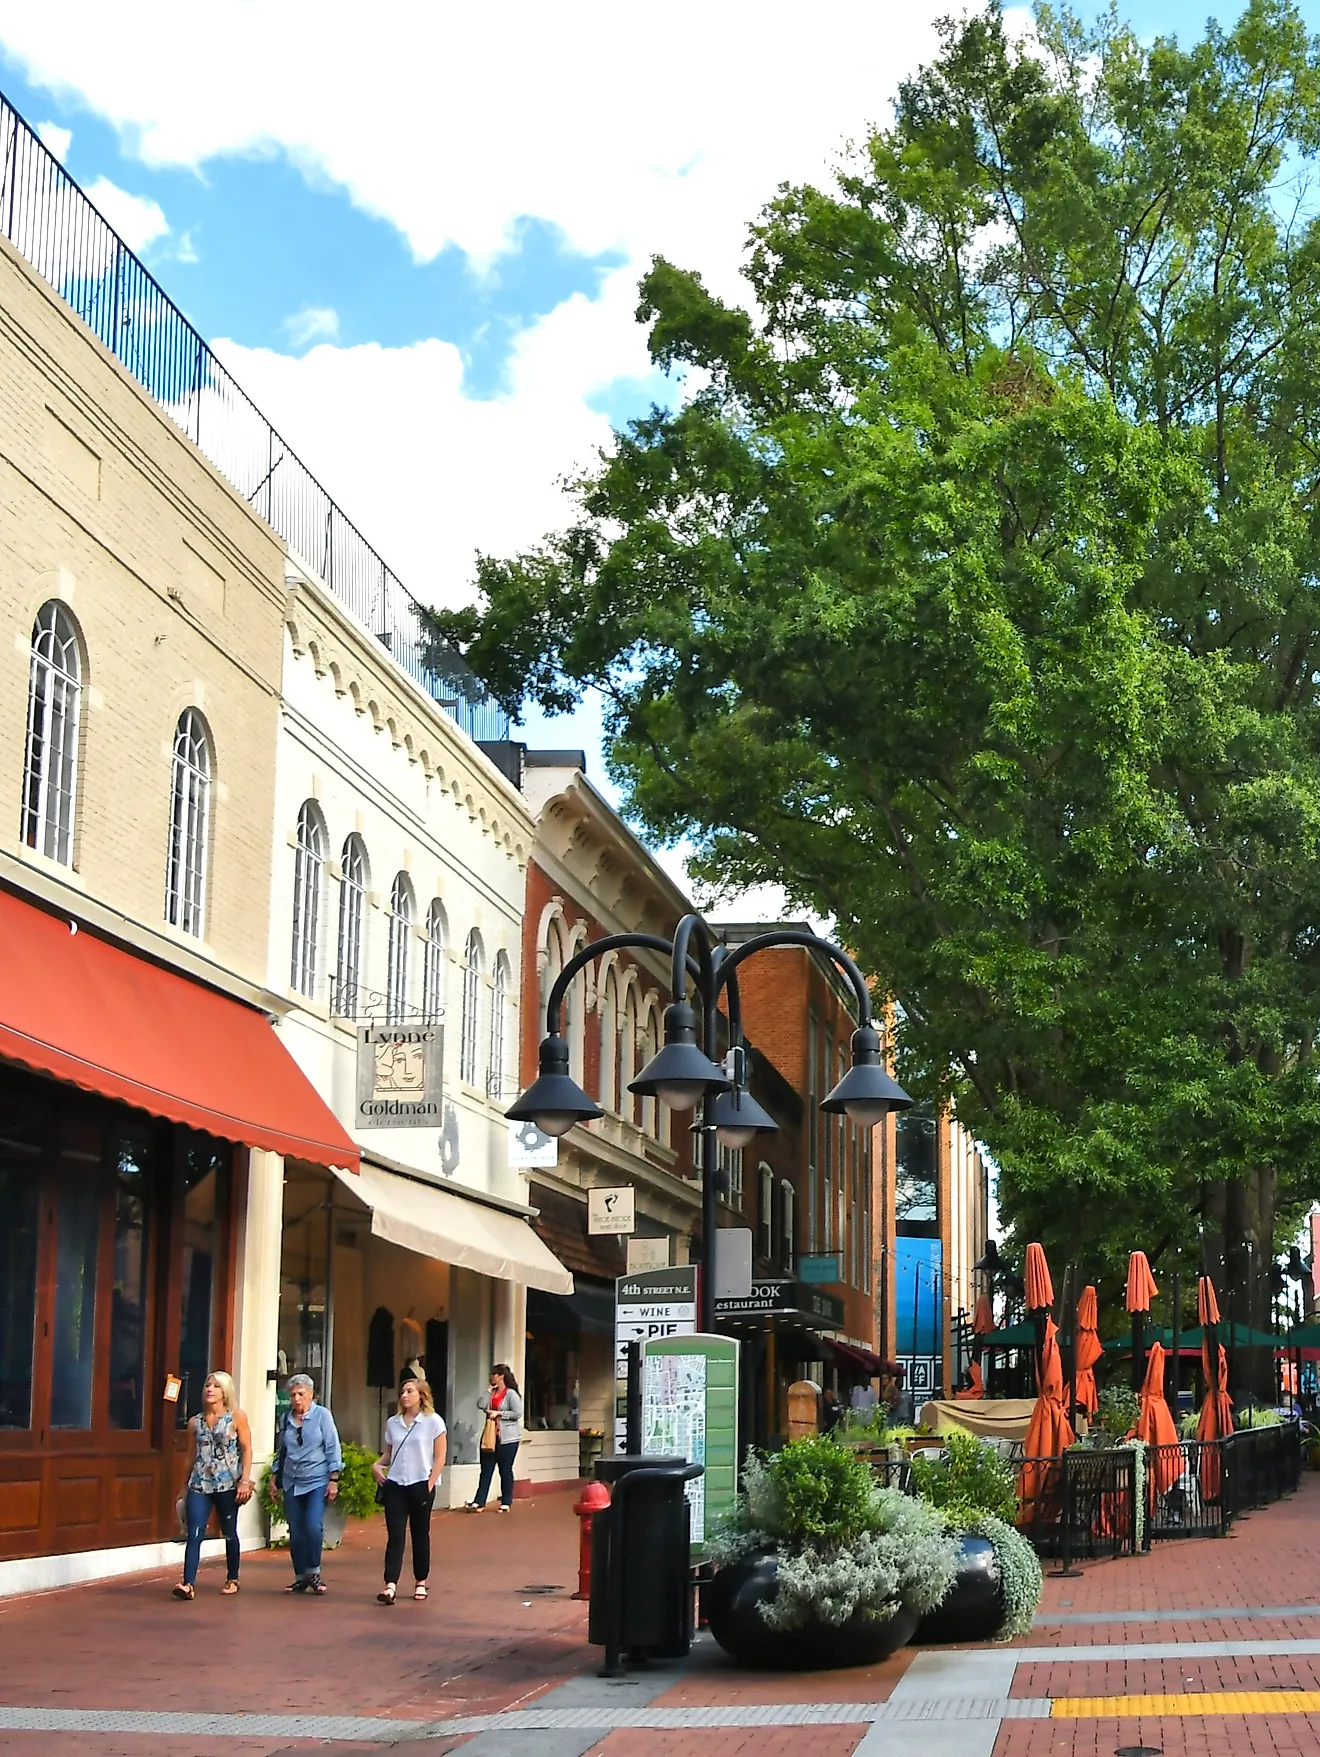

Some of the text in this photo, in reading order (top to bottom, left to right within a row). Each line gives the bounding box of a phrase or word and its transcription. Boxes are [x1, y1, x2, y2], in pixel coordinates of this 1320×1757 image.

[364, 1028, 435, 1047] Lynne
[360, 1099, 438, 1116] Goldman
[621, 1283, 641, 1295] 4th
[643, 1286, 674, 1295] STREET
[750, 1286, 780, 1298] OOK
[714, 1299, 774, 1310] estaurant
[639, 1307, 671, 1317] WINE
